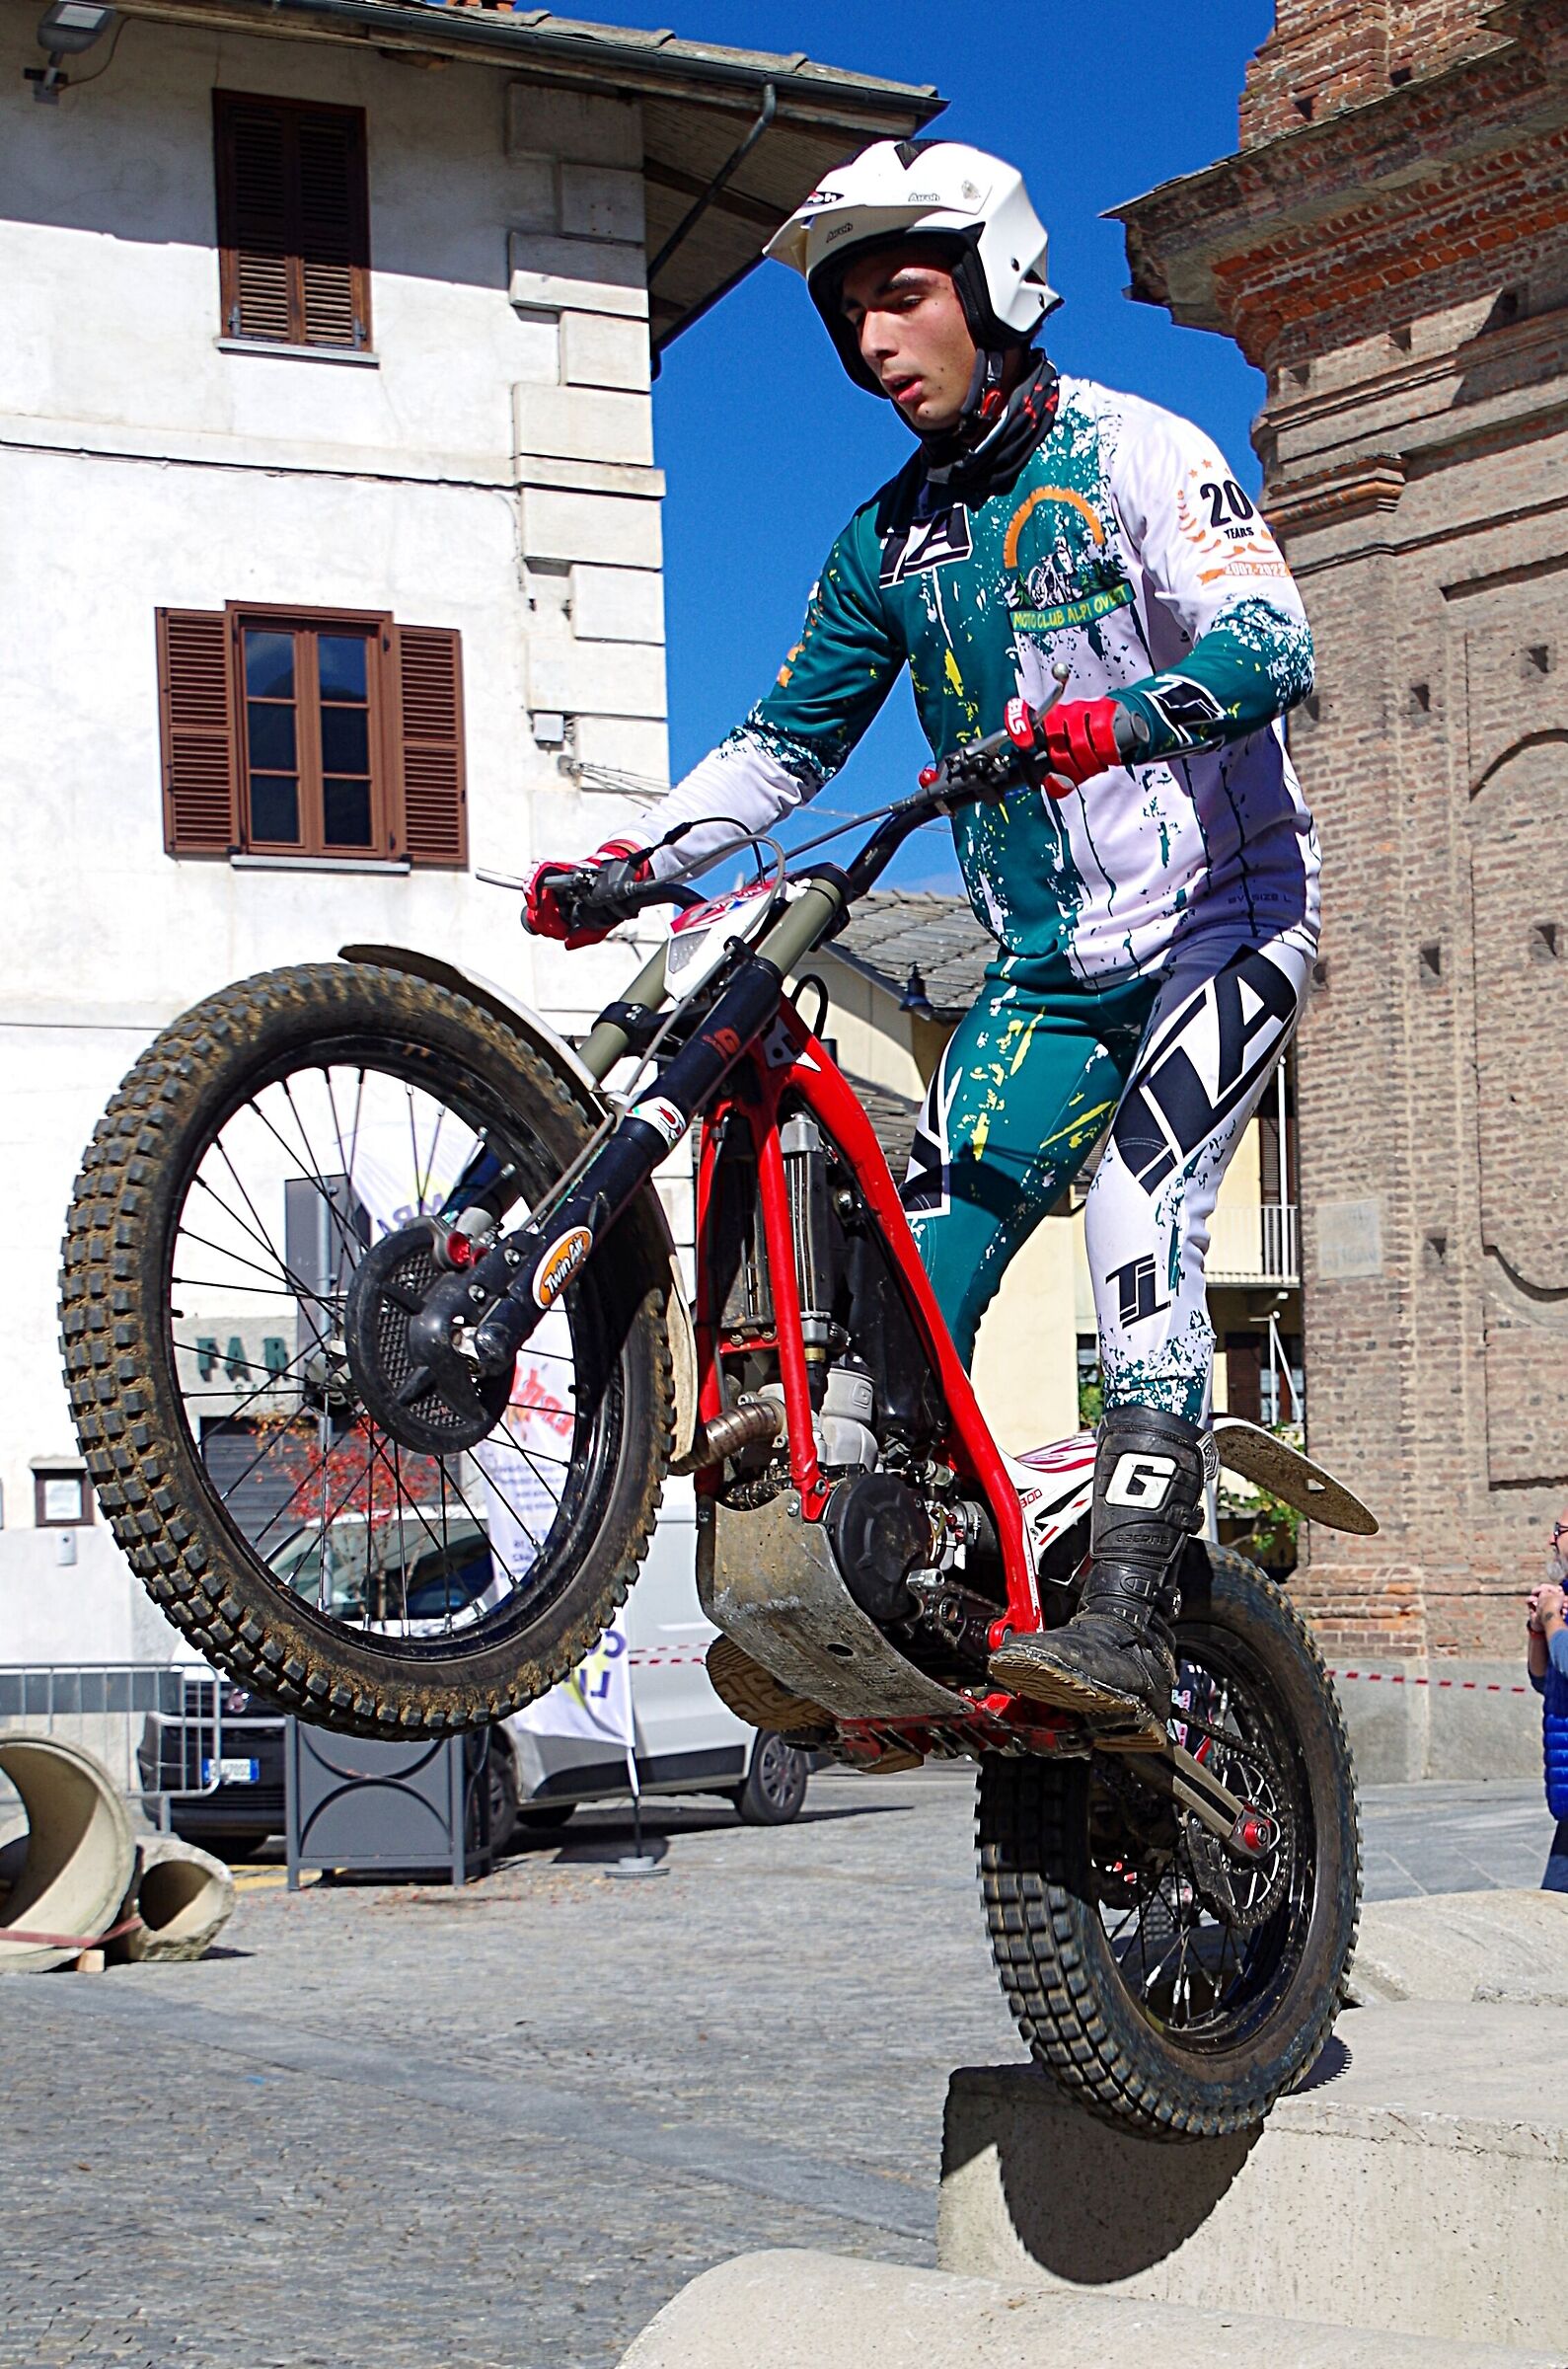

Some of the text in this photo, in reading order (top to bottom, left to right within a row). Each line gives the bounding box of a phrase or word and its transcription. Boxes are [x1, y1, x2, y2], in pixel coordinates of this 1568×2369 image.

[1200, 480, 1253, 528] 20
[1224, 527, 1254, 539] YEARS
[1012, 611, 1037, 629] MOTO
[1037, 609, 1066, 629] CLUB
[1067, 603, 1092, 624] ALPI
[544, 1256, 571, 1294] Twin
